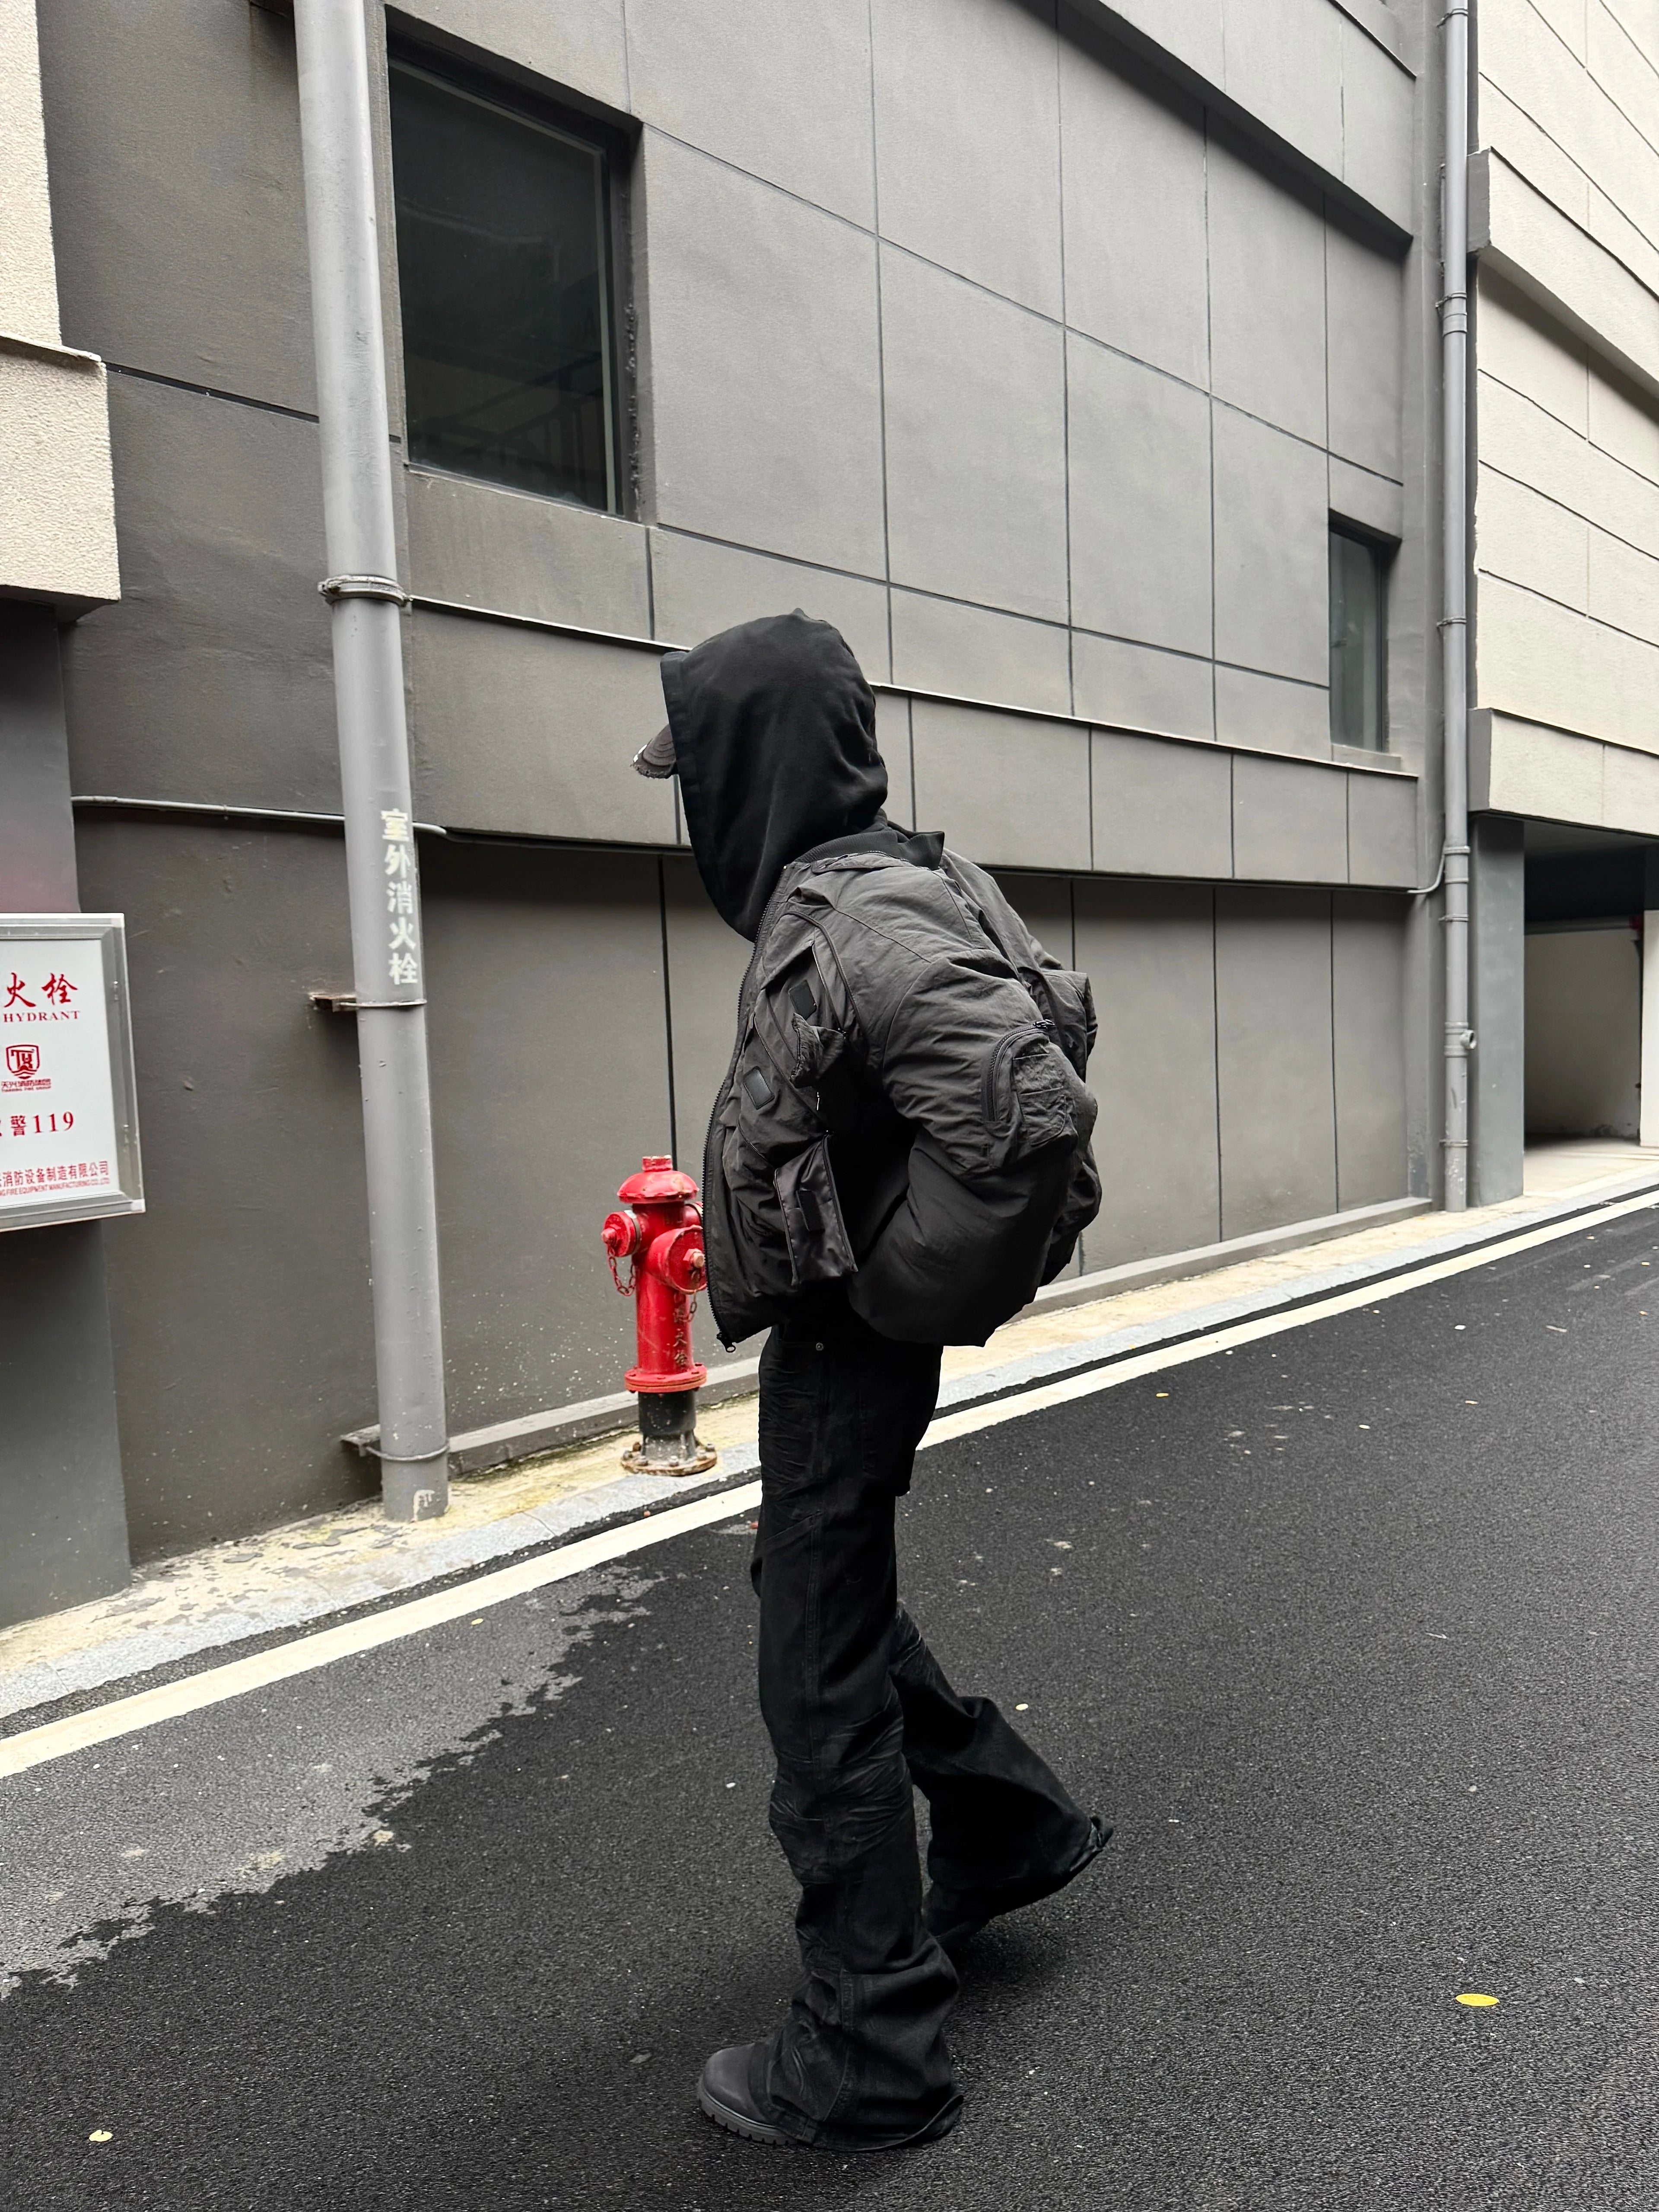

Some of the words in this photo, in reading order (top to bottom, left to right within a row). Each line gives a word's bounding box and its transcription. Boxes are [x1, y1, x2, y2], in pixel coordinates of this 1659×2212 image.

[381, 808, 418, 985] 室外消火栓
[4, 972, 78, 1007] 火栓
[3, 1011, 80, 1022] HYDRANT
[0, 1161, 108, 1187] 消防设备制造有限公司
